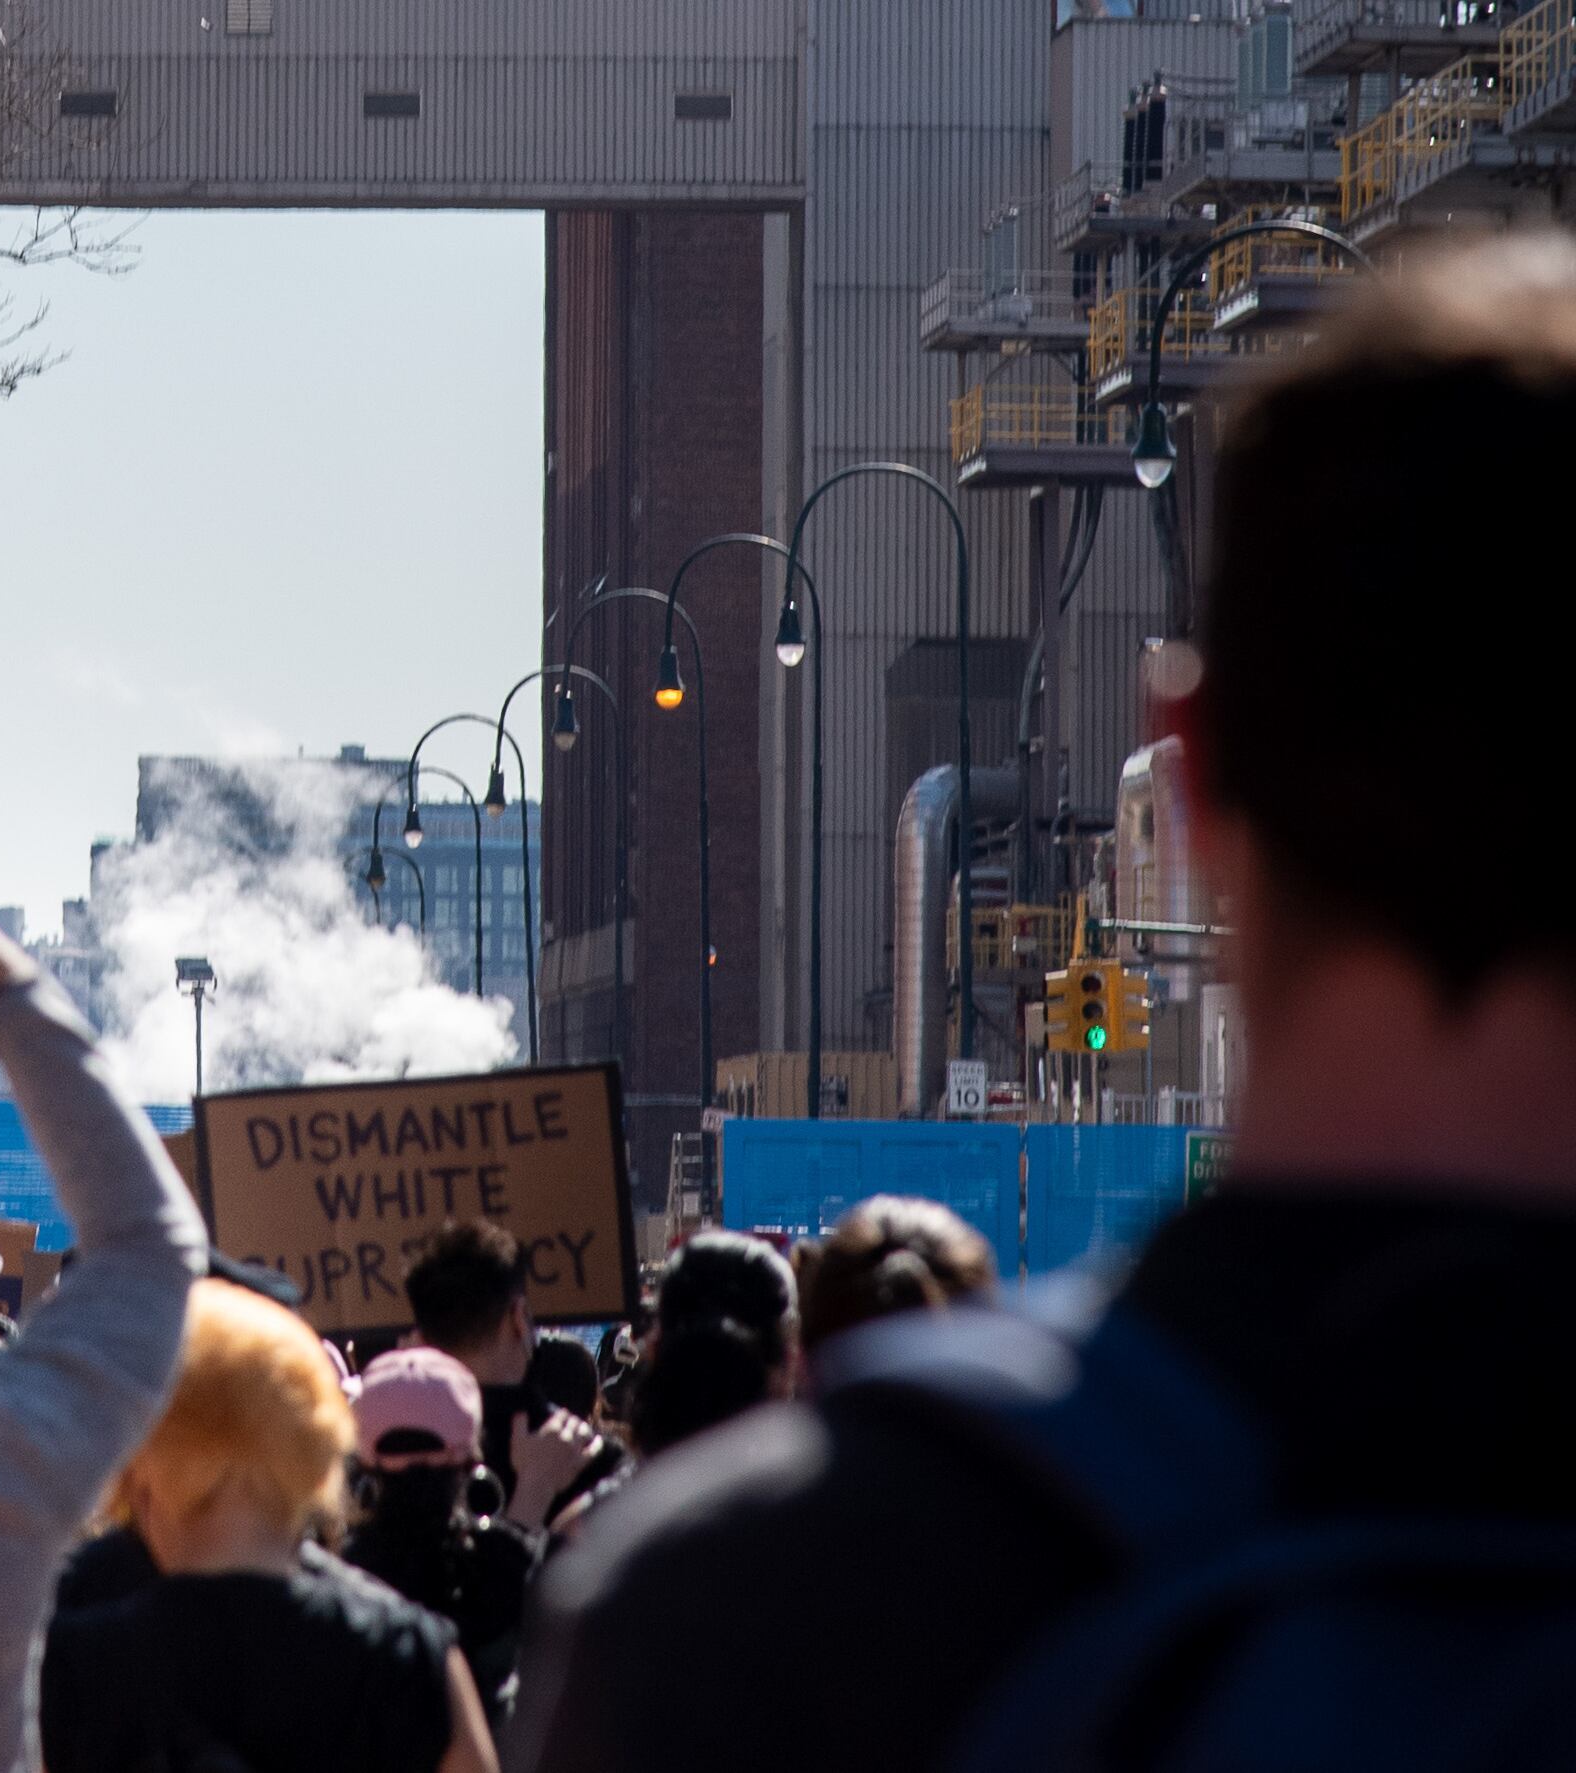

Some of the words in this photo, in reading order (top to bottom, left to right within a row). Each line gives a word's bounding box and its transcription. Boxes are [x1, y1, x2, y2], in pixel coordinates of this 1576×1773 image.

[245, 1089, 568, 1170] DISMANTLE
[956, 1087, 980, 1109] 10
[315, 1163, 511, 1223] WHITE
[241, 1229, 595, 1308] UPRCY
